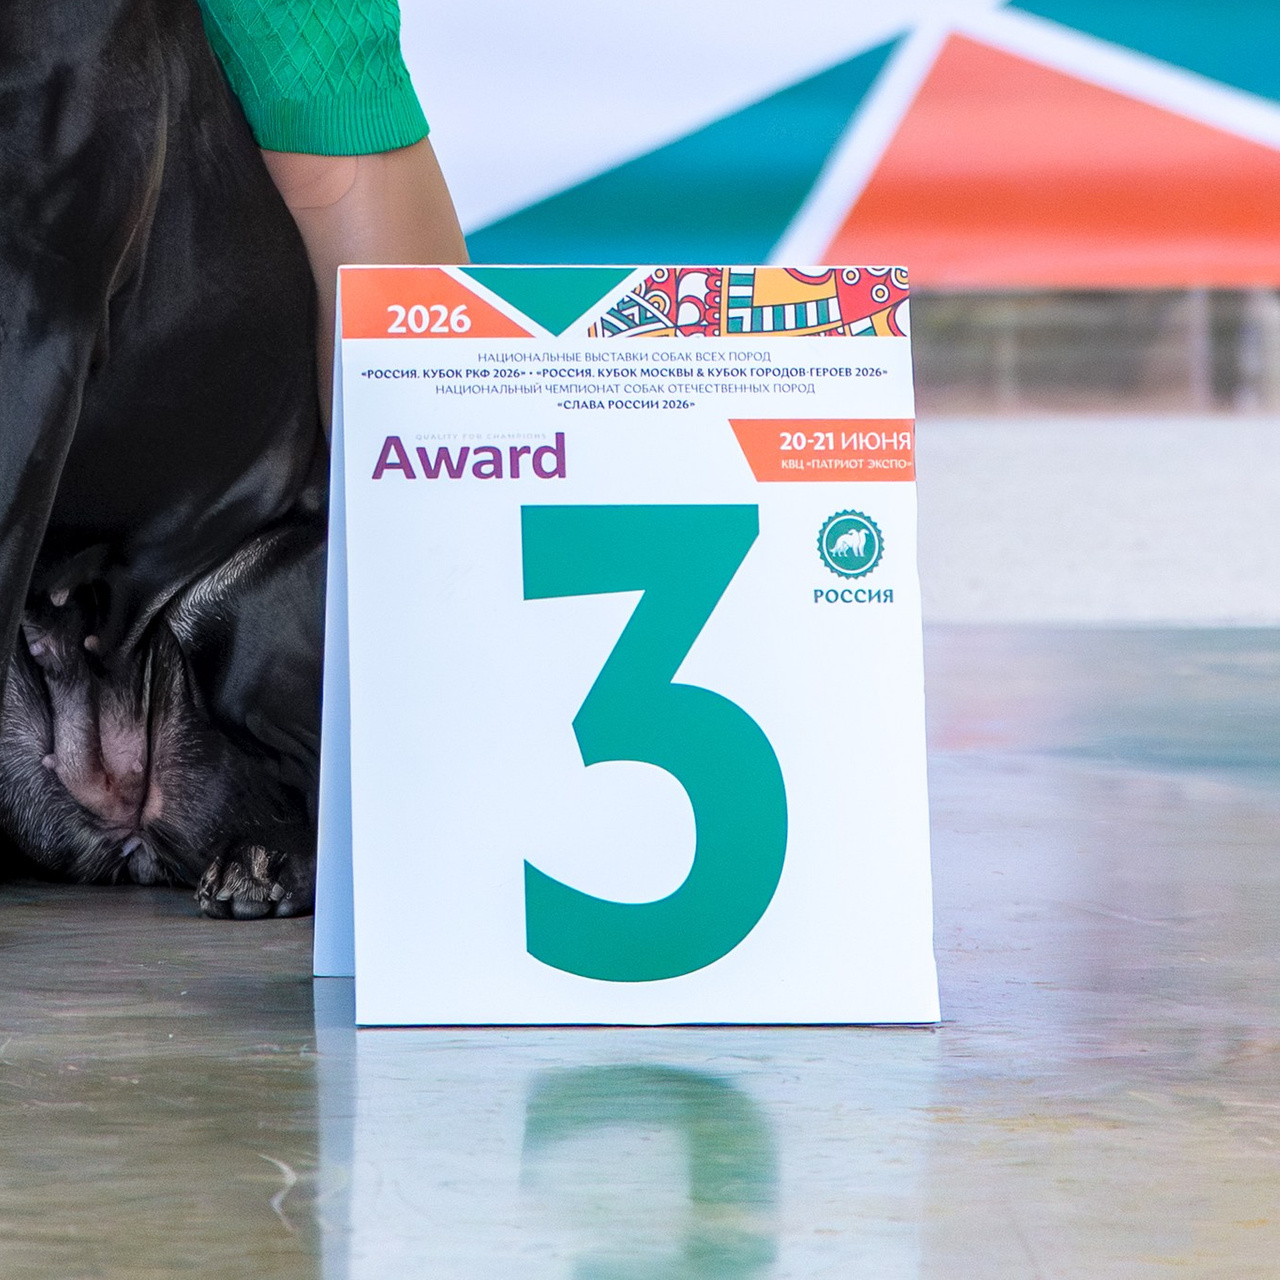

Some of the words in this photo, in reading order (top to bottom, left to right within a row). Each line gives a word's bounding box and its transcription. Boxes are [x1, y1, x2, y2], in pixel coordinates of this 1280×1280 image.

[387, 305, 472, 333] 2026
[478, 352, 582, 364] НАЦИОНАЛЬНЫЕ
[585, 352, 649, 363] ВЫСТАВКИ
[652, 352, 693, 362] СОБАК
[696, 352, 726, 362] ВСЕХ
[729, 352, 772, 363] ПОРОД
[361, 369, 420, 379] «РОССИЯ.
[423, 369, 463, 379] КУБОК
[466, 369, 490, 379] РКФ
[493, 369, 526, 379] 2026»
[536, 368, 595, 378] «РОССИЯ.
[598, 368, 637, 378] КУБОК
[640, 368, 694, 378] МОСКВЫ
[697, 368, 705, 378] &
[708, 368, 747, 378] КУБОК
[750, 367, 852, 378] ГОРОДОВ-ГЕРОЕВ
[855, 367, 888, 377] 2026»
[436, 383, 542, 396] НАЦИОНАЛЬНЫЙ
[545, 384, 620, 394] ЧЕМПИОНАТ
[624, 384, 665, 394] СОБАК
[669, 383, 770, 394] ОТЕЧЕСТВЕННЫХ
[774, 383, 815, 394] ПОРОД
[558, 400, 605, 410] «СЛАВА
[608, 400, 660, 410] РОССИИ
[662, 400, 696, 410] 2026»
[779, 432, 835, 451] 20-21
[841, 432, 911, 450] ИЮНЯ
[372, 432, 566, 480] Award
[781, 460, 804, 471] КВЦ
[806, 459, 863, 469] «ПАТРИОТ
[868, 459, 912, 469] ЭКСПО»
[813, 588, 894, 604] РОССИЯ
[520, 504, 789, 983] 3
